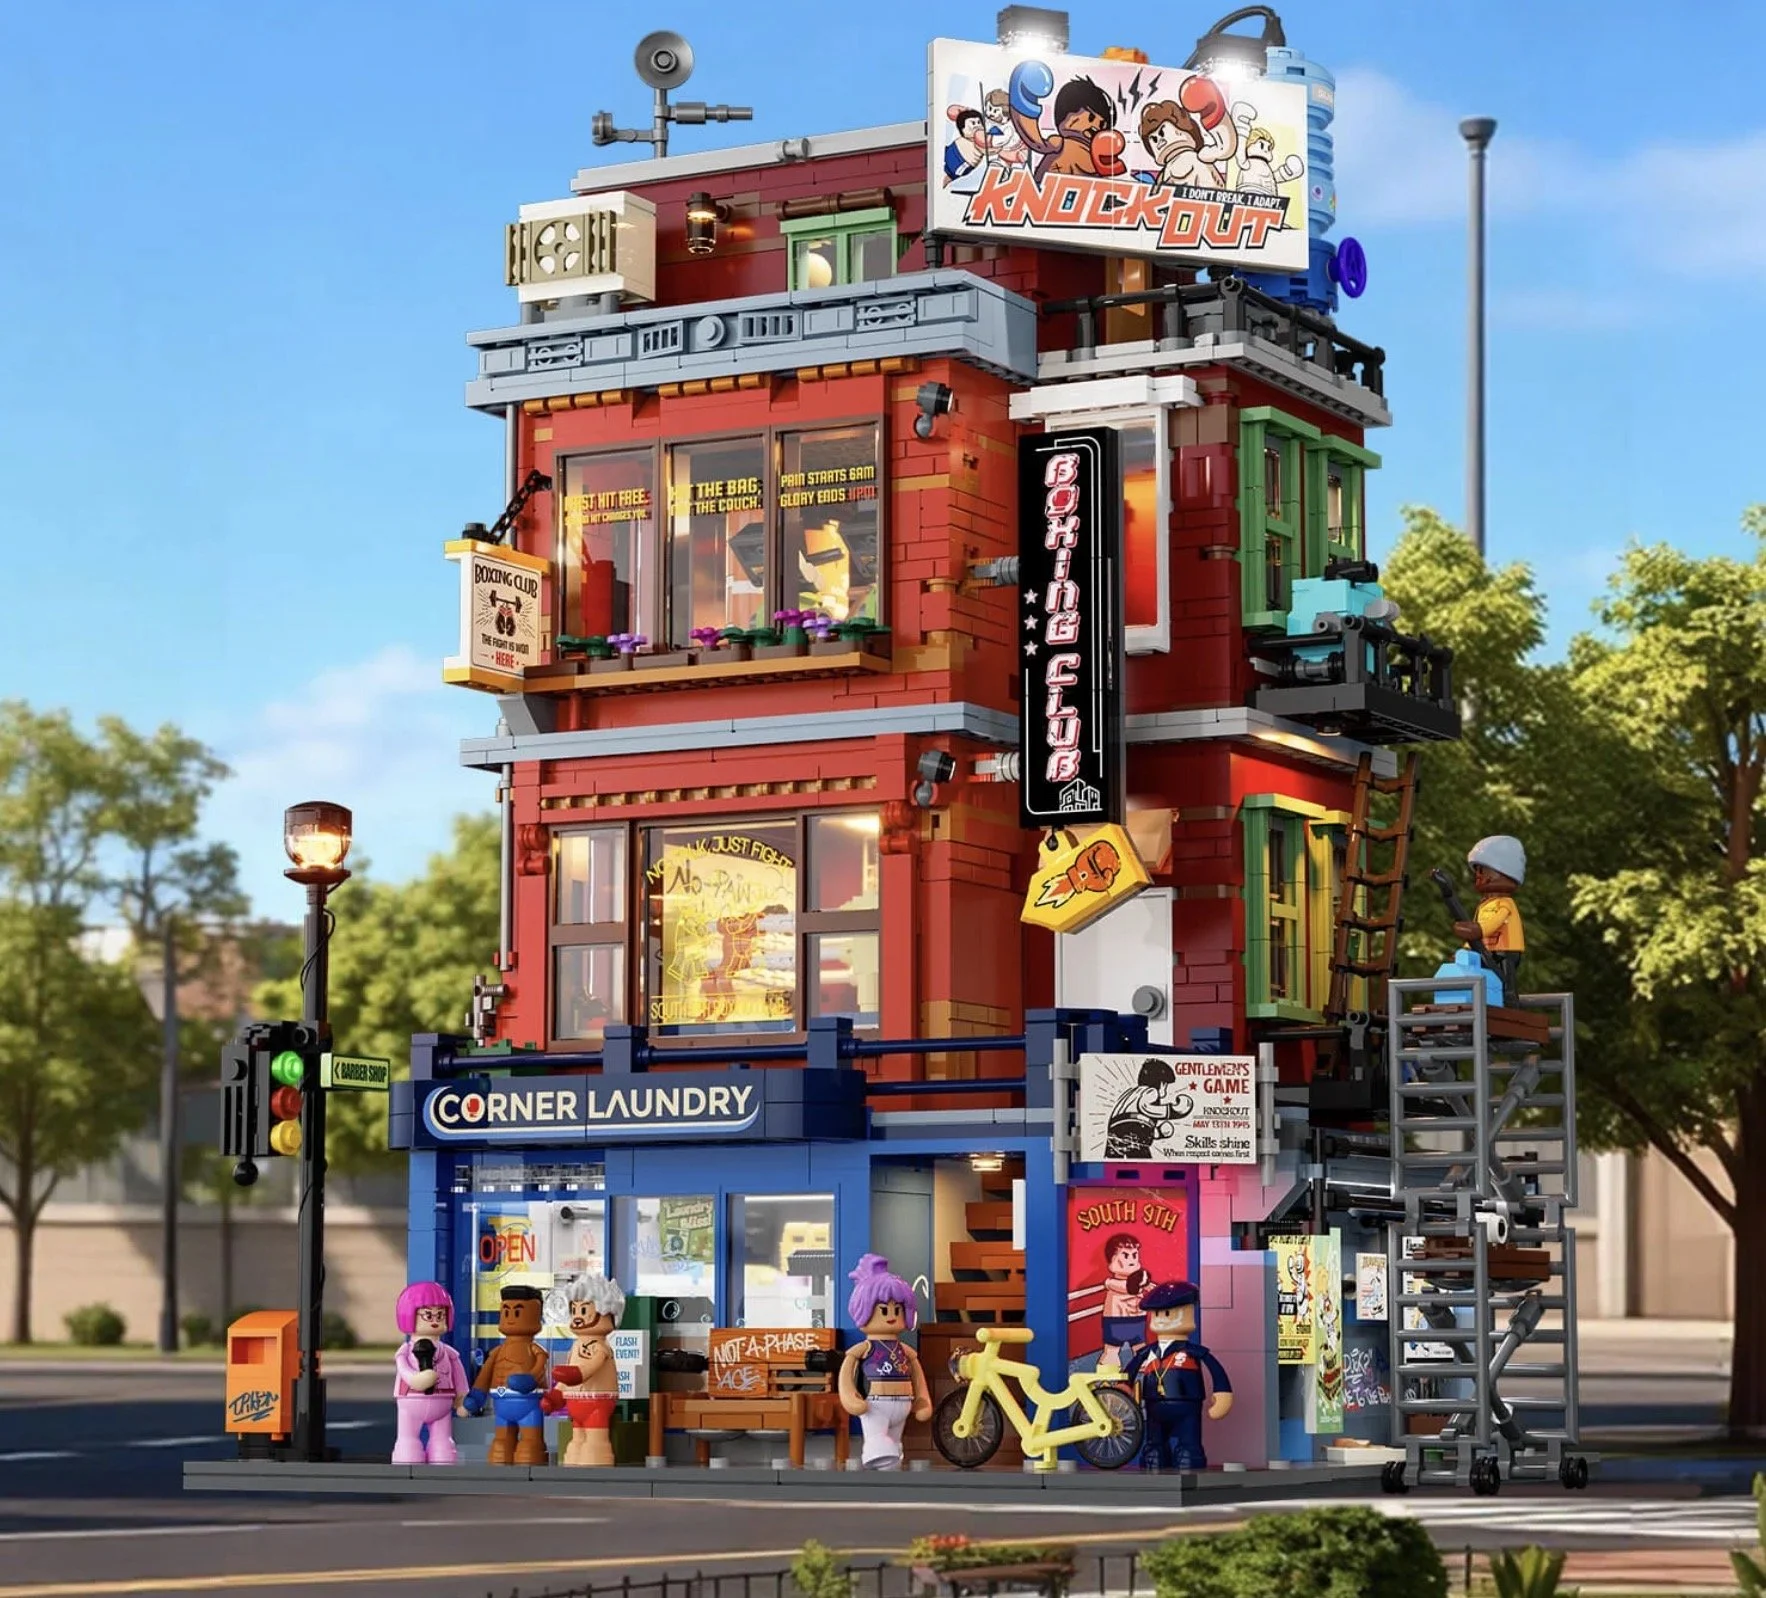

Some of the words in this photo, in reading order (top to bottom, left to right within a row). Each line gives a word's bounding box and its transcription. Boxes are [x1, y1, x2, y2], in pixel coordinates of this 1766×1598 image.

[1189, 188, 1214, 202] DON'T
[781, 472, 805, 488] PAIN
[807, 468, 846, 485] STARTS
[849, 465, 874, 481] 6AM
[697, 481, 723, 498] THE
[780, 491, 814, 507] GLORY
[817, 488, 846, 504] ENDS
[598, 491, 617, 510] HIT
[696, 499, 716, 514] THE
[719, 496, 761, 512] COUCH.
[1045, 452, 1081, 646] BOXING
[474, 563, 513, 587] BOXING
[514, 574, 538, 598] CLUB
[481, 633, 492, 647] THE
[492, 637, 508, 650] FIGHT
[508, 641, 515, 651] IS
[495, 652, 515, 668] HERE
[1045, 652, 1081, 782] CLUB
[712, 836, 750, 854] JUST
[751, 842, 793, 871] FIGHT
[341, 1062, 368, 1081] BARBER
[369, 1065, 387, 1083] SHOP
[1174, 1062, 1250, 1076] GENTLEMEN'S
[1204, 1078, 1250, 1094] GAME
[438, 1090, 578, 1125] CORNER
[588, 1085, 753, 1120] LAUNDRY
[1203, 1106, 1250, 1116] KNOCKOUT
[1185, 1135, 1217, 1149] Skills
[1219, 1136, 1250, 1149] shine
[1077, 1200, 1137, 1230] SOUTH
[1143, 1204, 1179, 1232] 9TH
[480, 1234, 535, 1263] OPEN
[615, 1336, 637, 1346] FLASH
[615, 1349, 640, 1359] EVENT!
[713, 1336, 747, 1368] NOT
